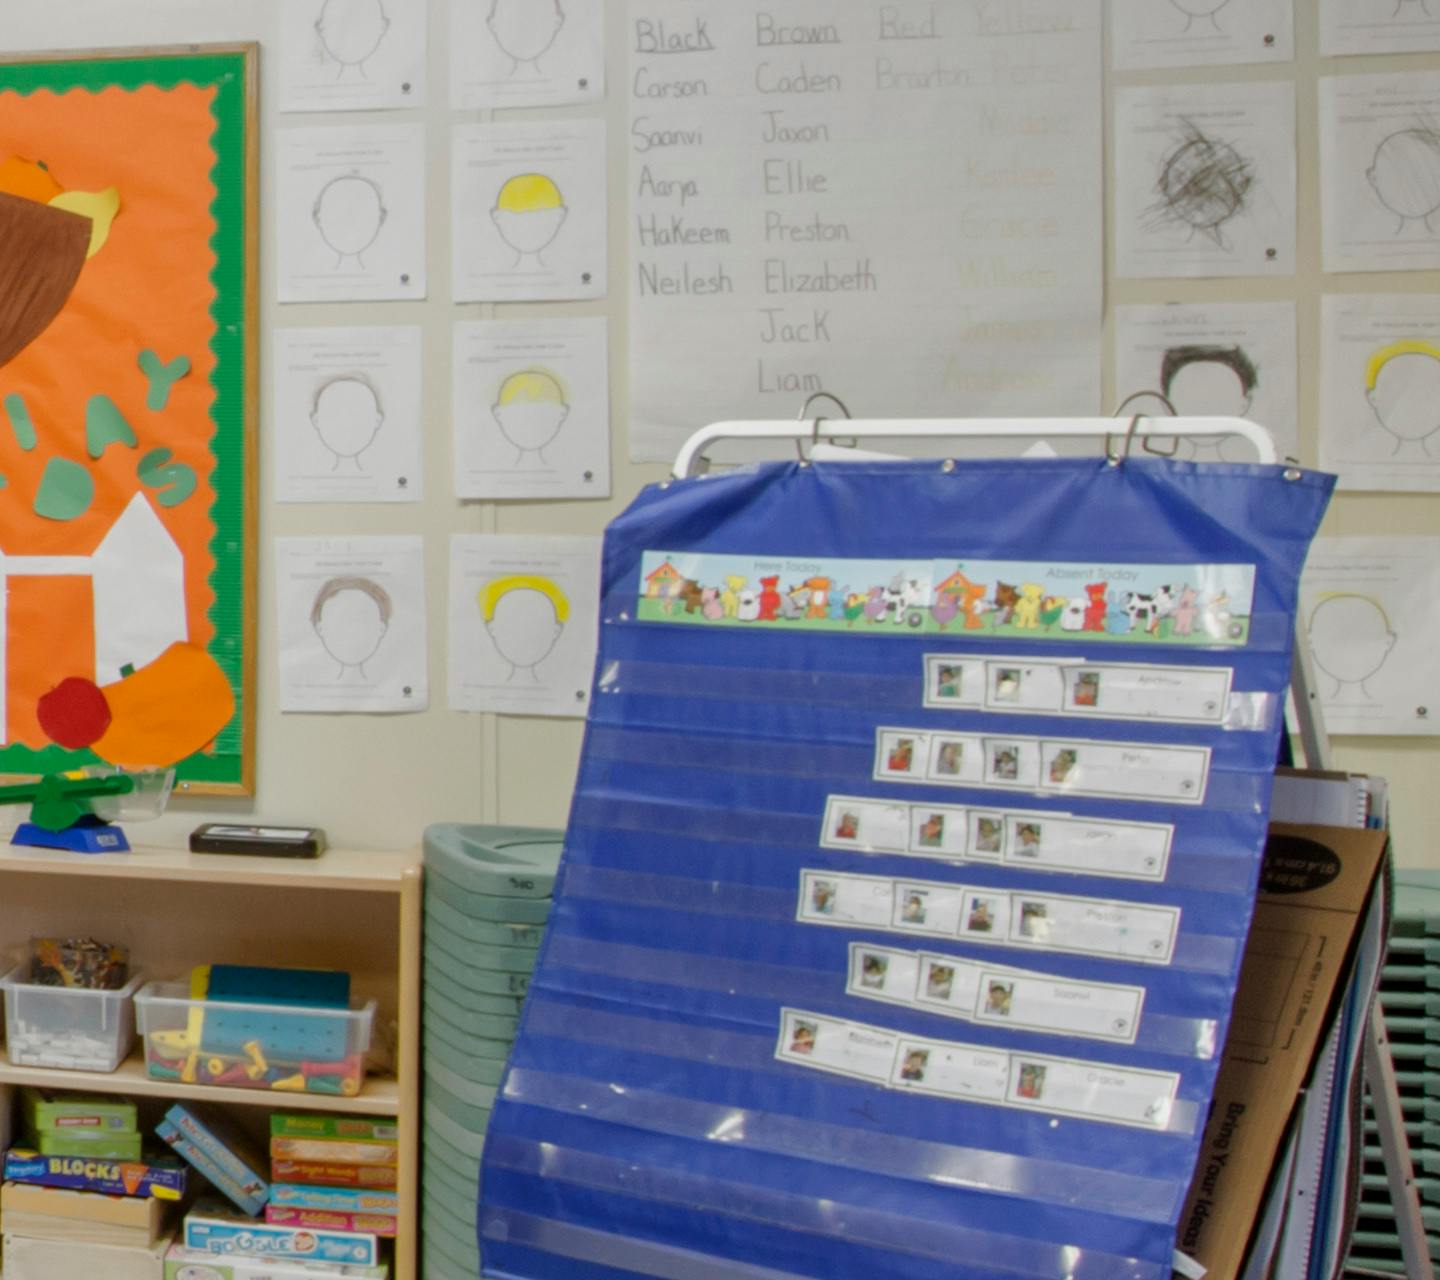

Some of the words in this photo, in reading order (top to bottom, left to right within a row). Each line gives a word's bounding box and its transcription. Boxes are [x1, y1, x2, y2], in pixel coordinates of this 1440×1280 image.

[755, 12, 842, 47] Brown
[879, 6, 942, 40] Red
[633, 66, 709, 100] Carson
[754, 60, 842, 95] Caden
[760, 110, 830, 144] Jaxon
[762, 159, 829, 195] Ellie
[765, 210, 850, 243] Preston
[638, 262, 734, 297] Neilesh
[764, 256, 879, 295] Elizabeth
[757, 359, 824, 394] Liam
[783, 560, 824, 577] Today
[1045, 565, 1092, 582] Absent
[1094, 567, 1140, 584] Today
[1214, 1101, 1247, 1150] Bring
[49, 1158, 121, 1180] BLOCKS
[1200, 1150, 1230, 1196] Your
[1181, 1199, 1214, 1249] Ideas
